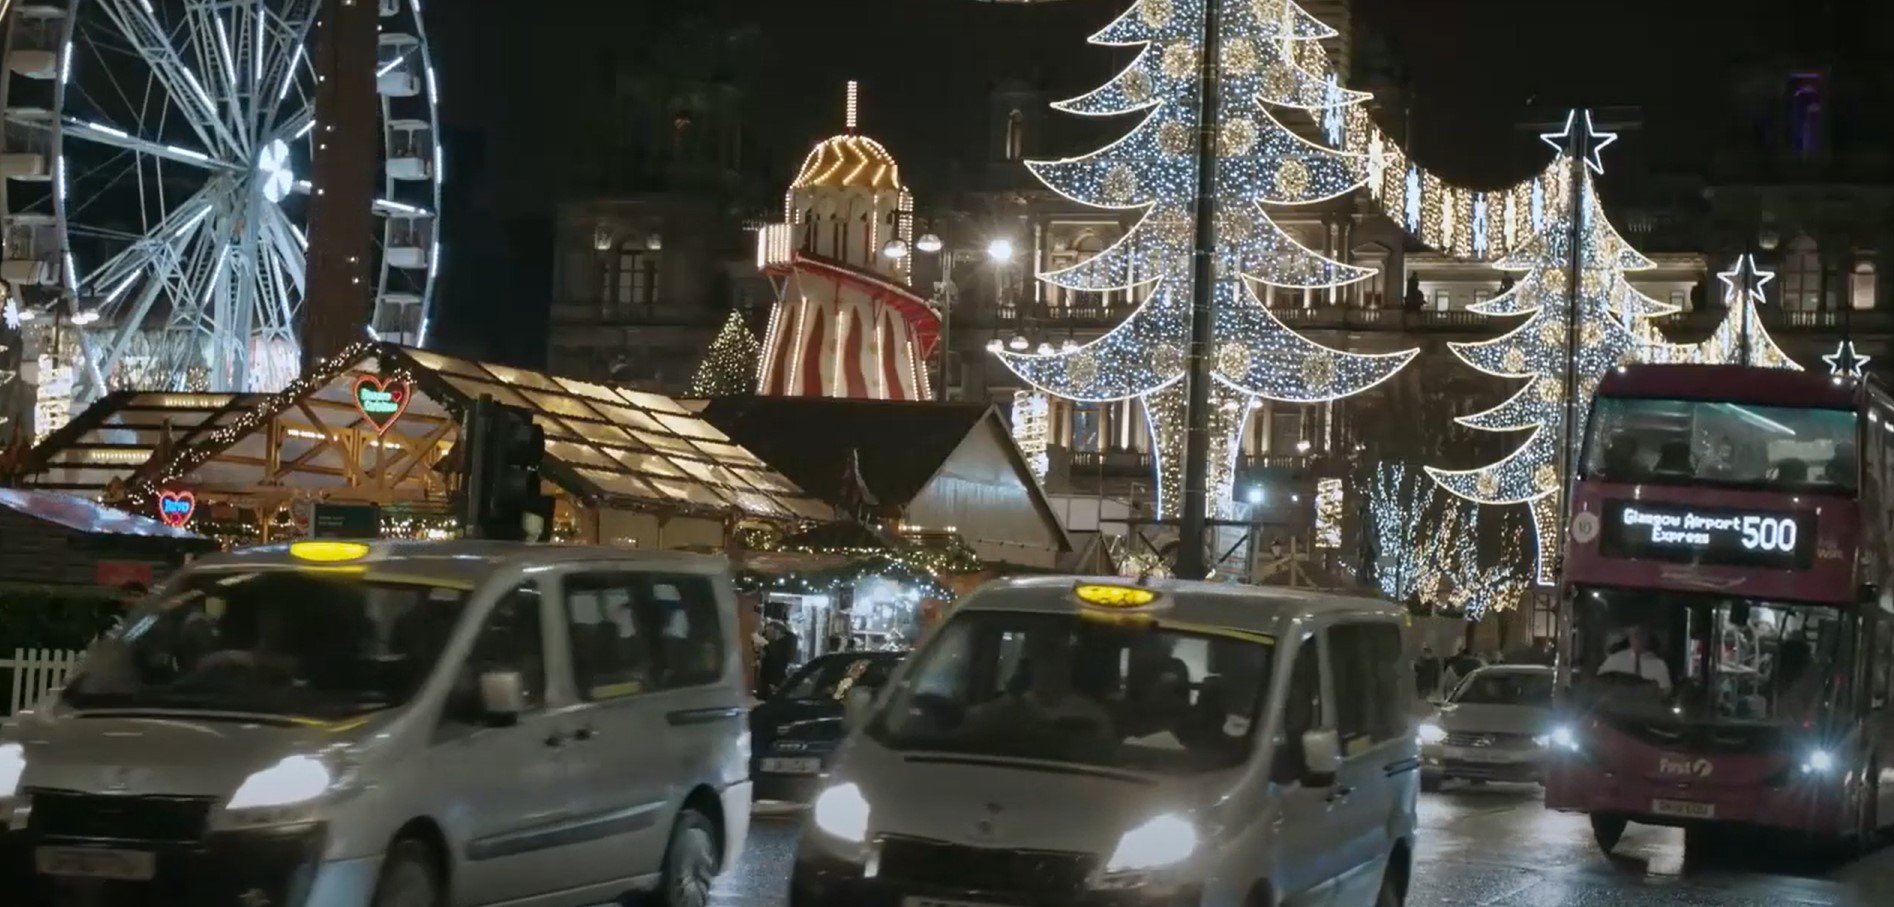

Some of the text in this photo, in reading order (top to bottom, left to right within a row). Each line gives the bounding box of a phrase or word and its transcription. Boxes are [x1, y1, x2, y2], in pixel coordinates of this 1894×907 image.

[1623, 507, 1741, 531] Glasgow Airport
[1652, 525, 1710, 545] Express
[1741, 516, 1797, 551] 500
[1659, 758, 1691, 774] First
